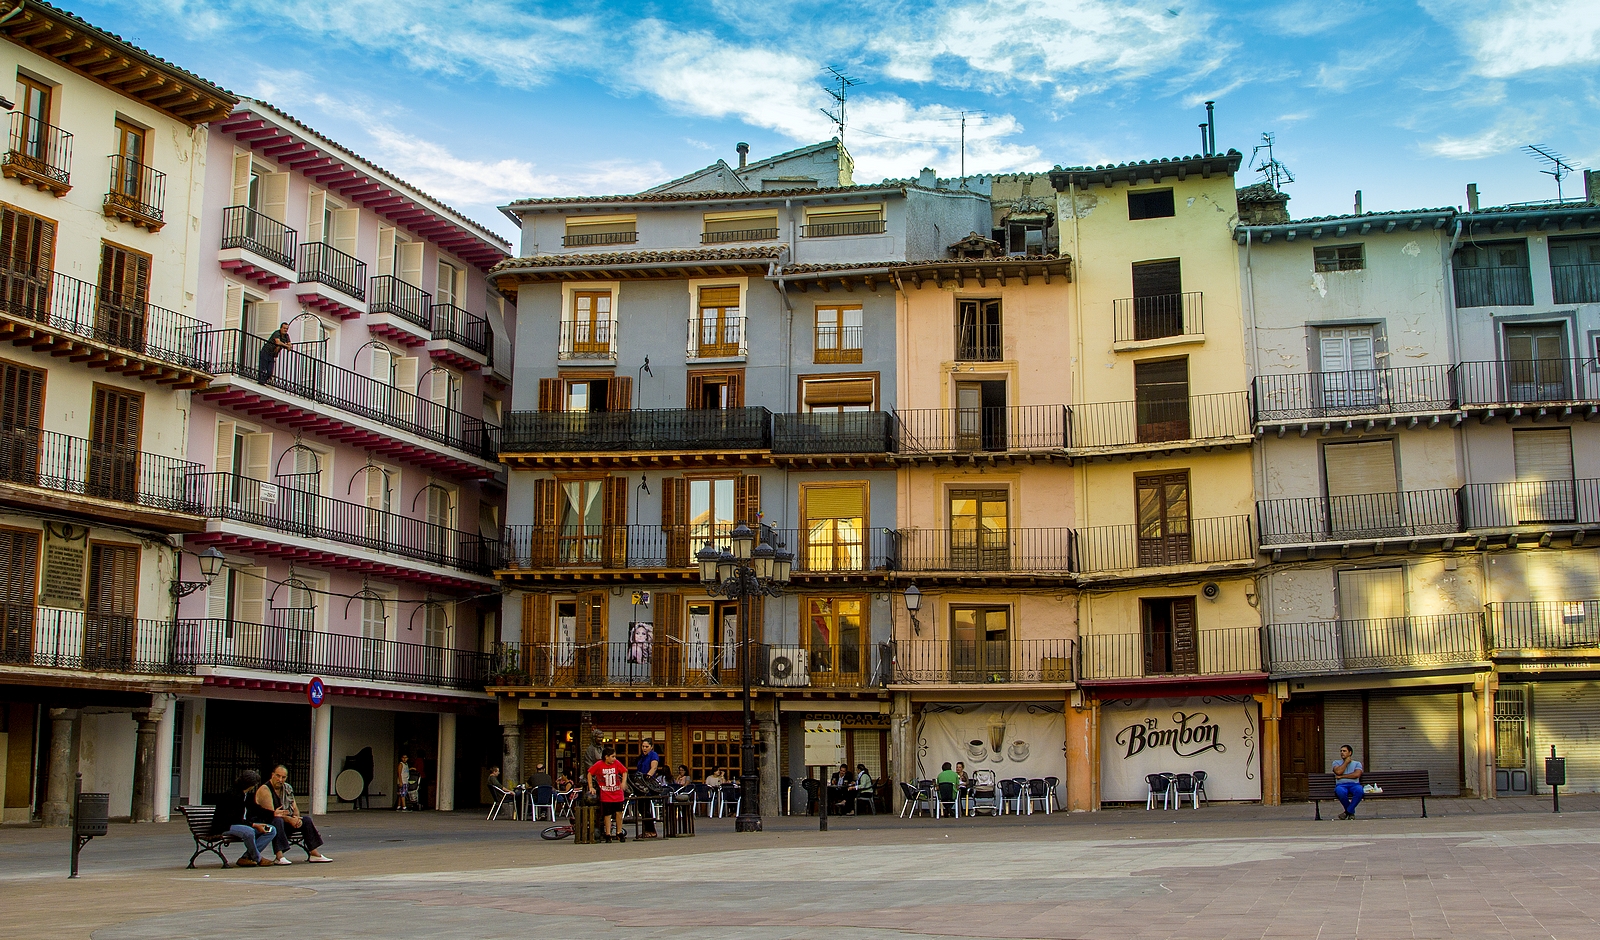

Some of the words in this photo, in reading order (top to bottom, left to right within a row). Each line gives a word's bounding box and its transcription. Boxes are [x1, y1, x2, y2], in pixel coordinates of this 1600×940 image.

[1144, 717, 1159, 730] El
[1115, 711, 1226, 760] Bombón
[603, 774, 616, 787] 10
